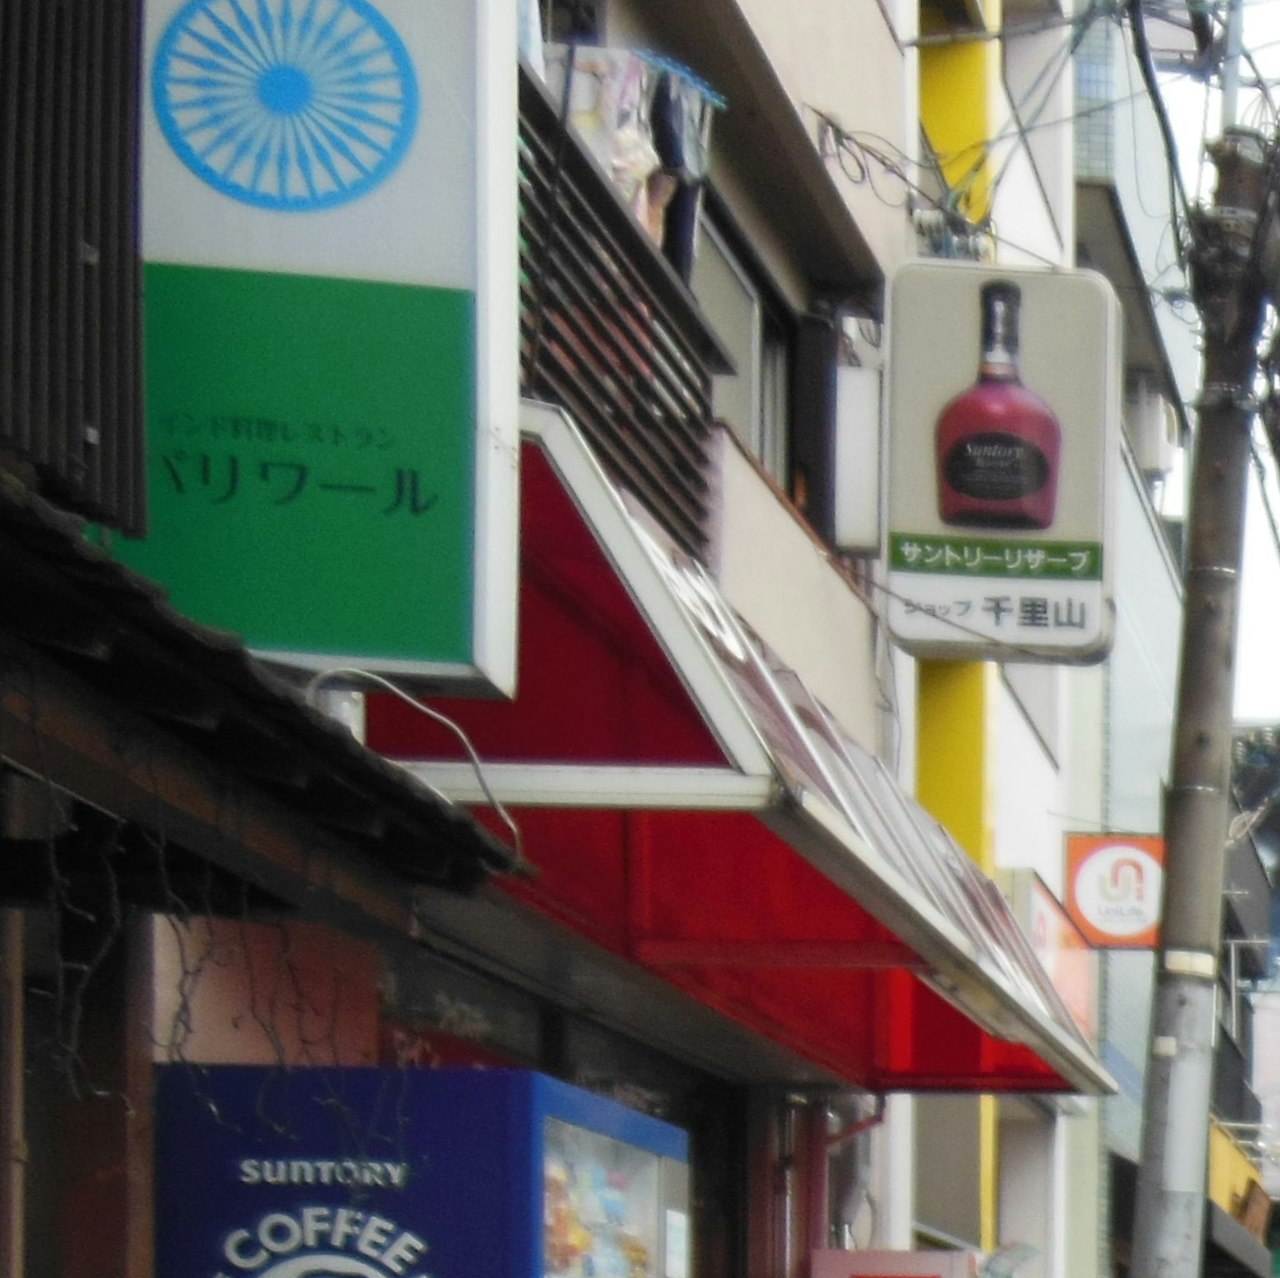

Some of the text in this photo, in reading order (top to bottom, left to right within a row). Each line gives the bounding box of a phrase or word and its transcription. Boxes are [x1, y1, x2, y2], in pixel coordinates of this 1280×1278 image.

[901, 541, 1090, 572] サントリーリザーブ
[981, 595, 1087, 629] 千里山
[223, 1206, 430, 1276] COFFEE
